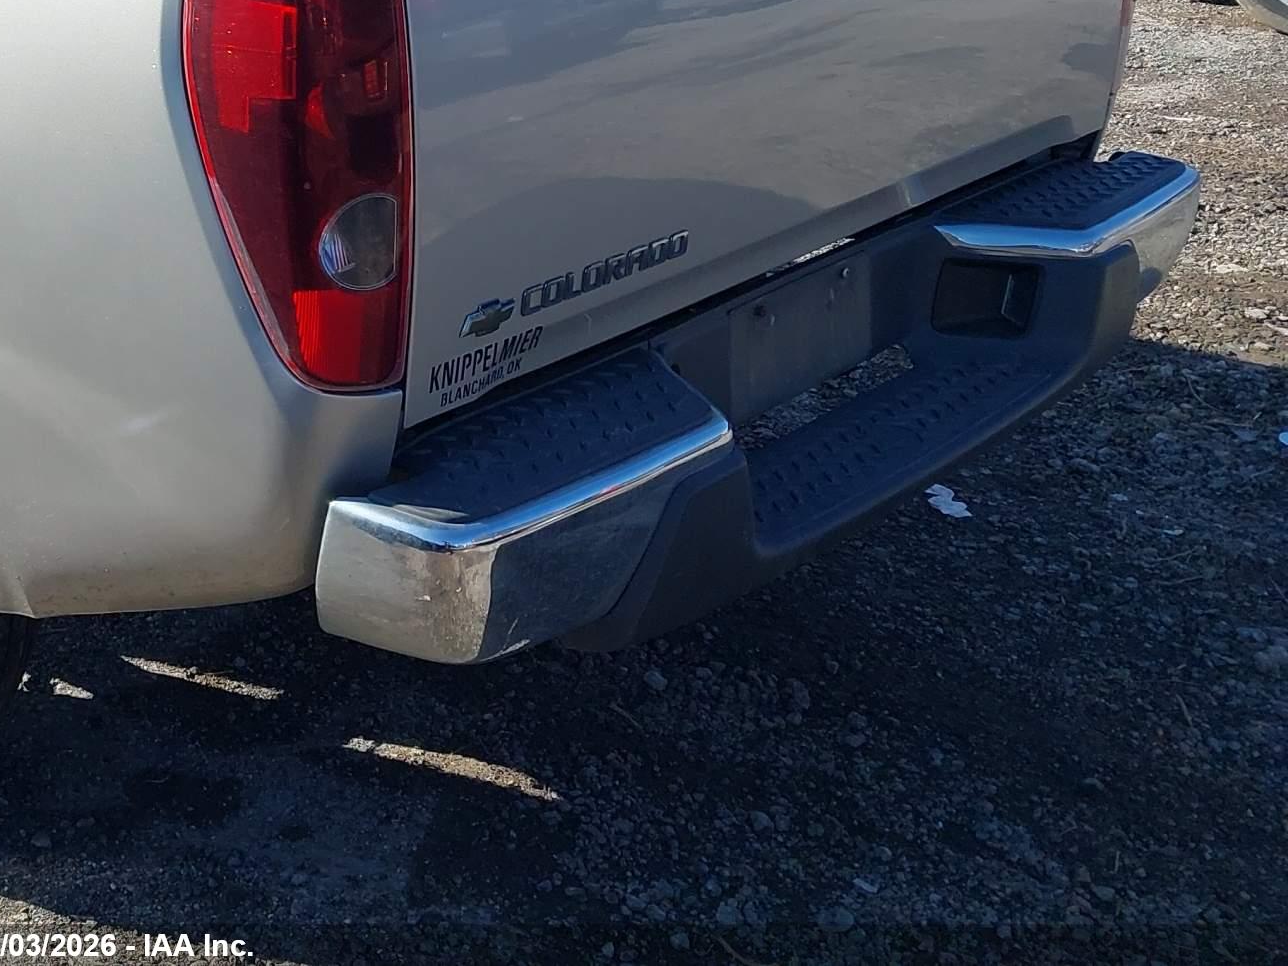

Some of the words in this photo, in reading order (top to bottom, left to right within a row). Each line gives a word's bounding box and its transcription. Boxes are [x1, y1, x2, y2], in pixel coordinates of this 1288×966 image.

[520, 229, 689, 317] COLORADO
[429, 325, 543, 394] KNIPPELMIER
[507, 357, 522, 374] OK
